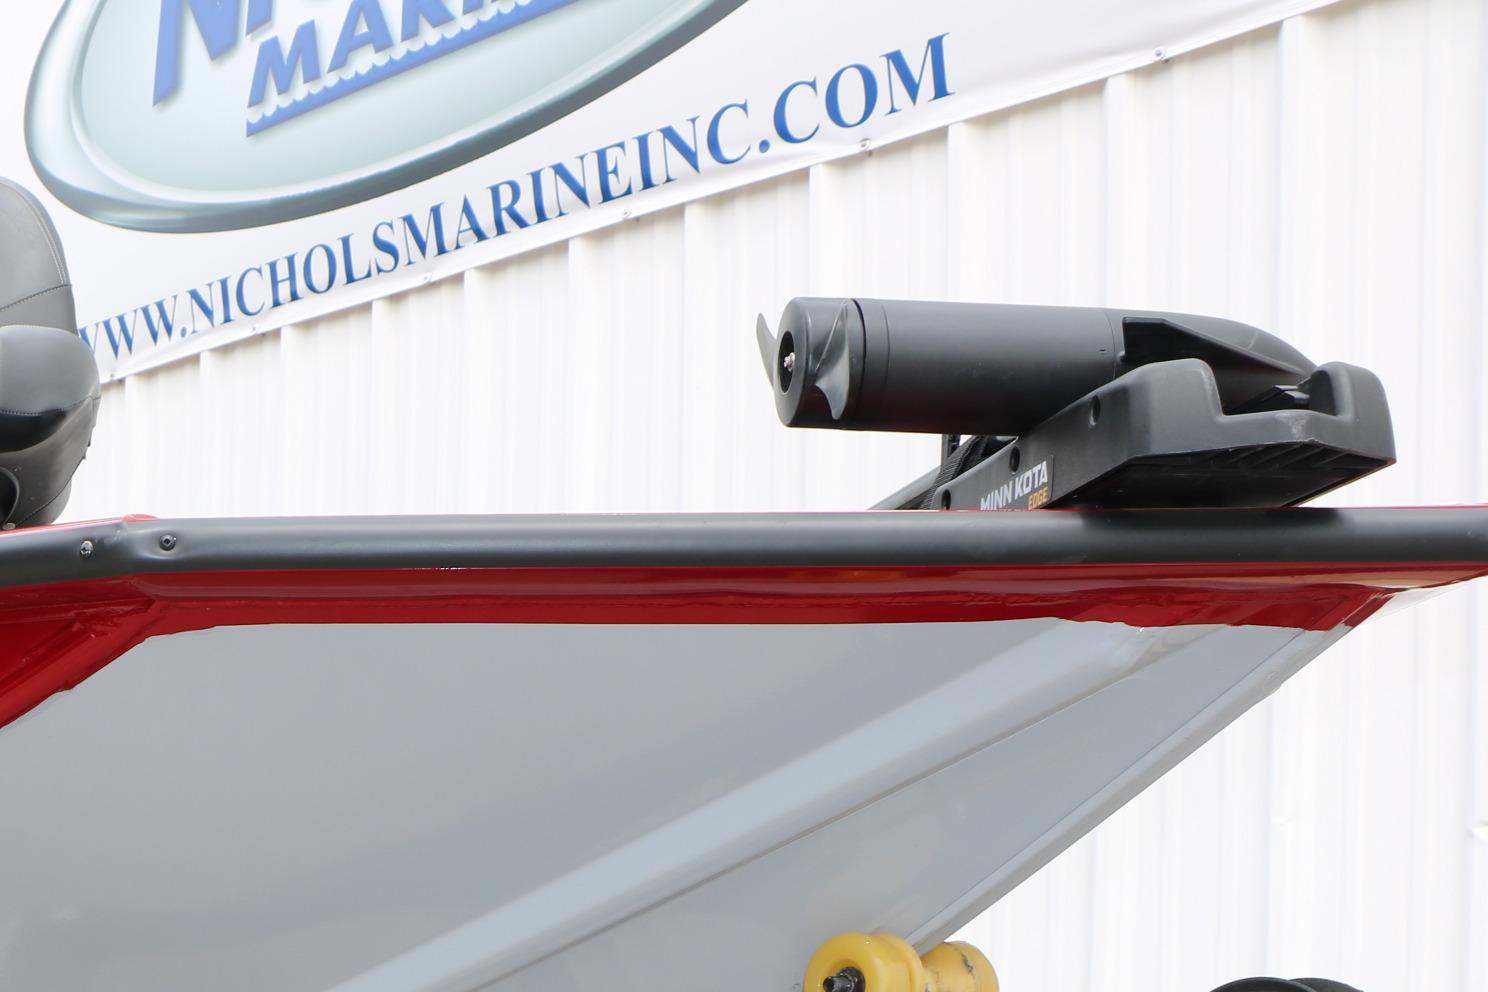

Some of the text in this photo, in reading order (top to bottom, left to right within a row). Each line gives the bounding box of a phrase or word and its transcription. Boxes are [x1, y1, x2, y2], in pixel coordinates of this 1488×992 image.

[980, 460, 1048, 510] MINN KOTA
[1028, 486, 1049, 510] EDGE
